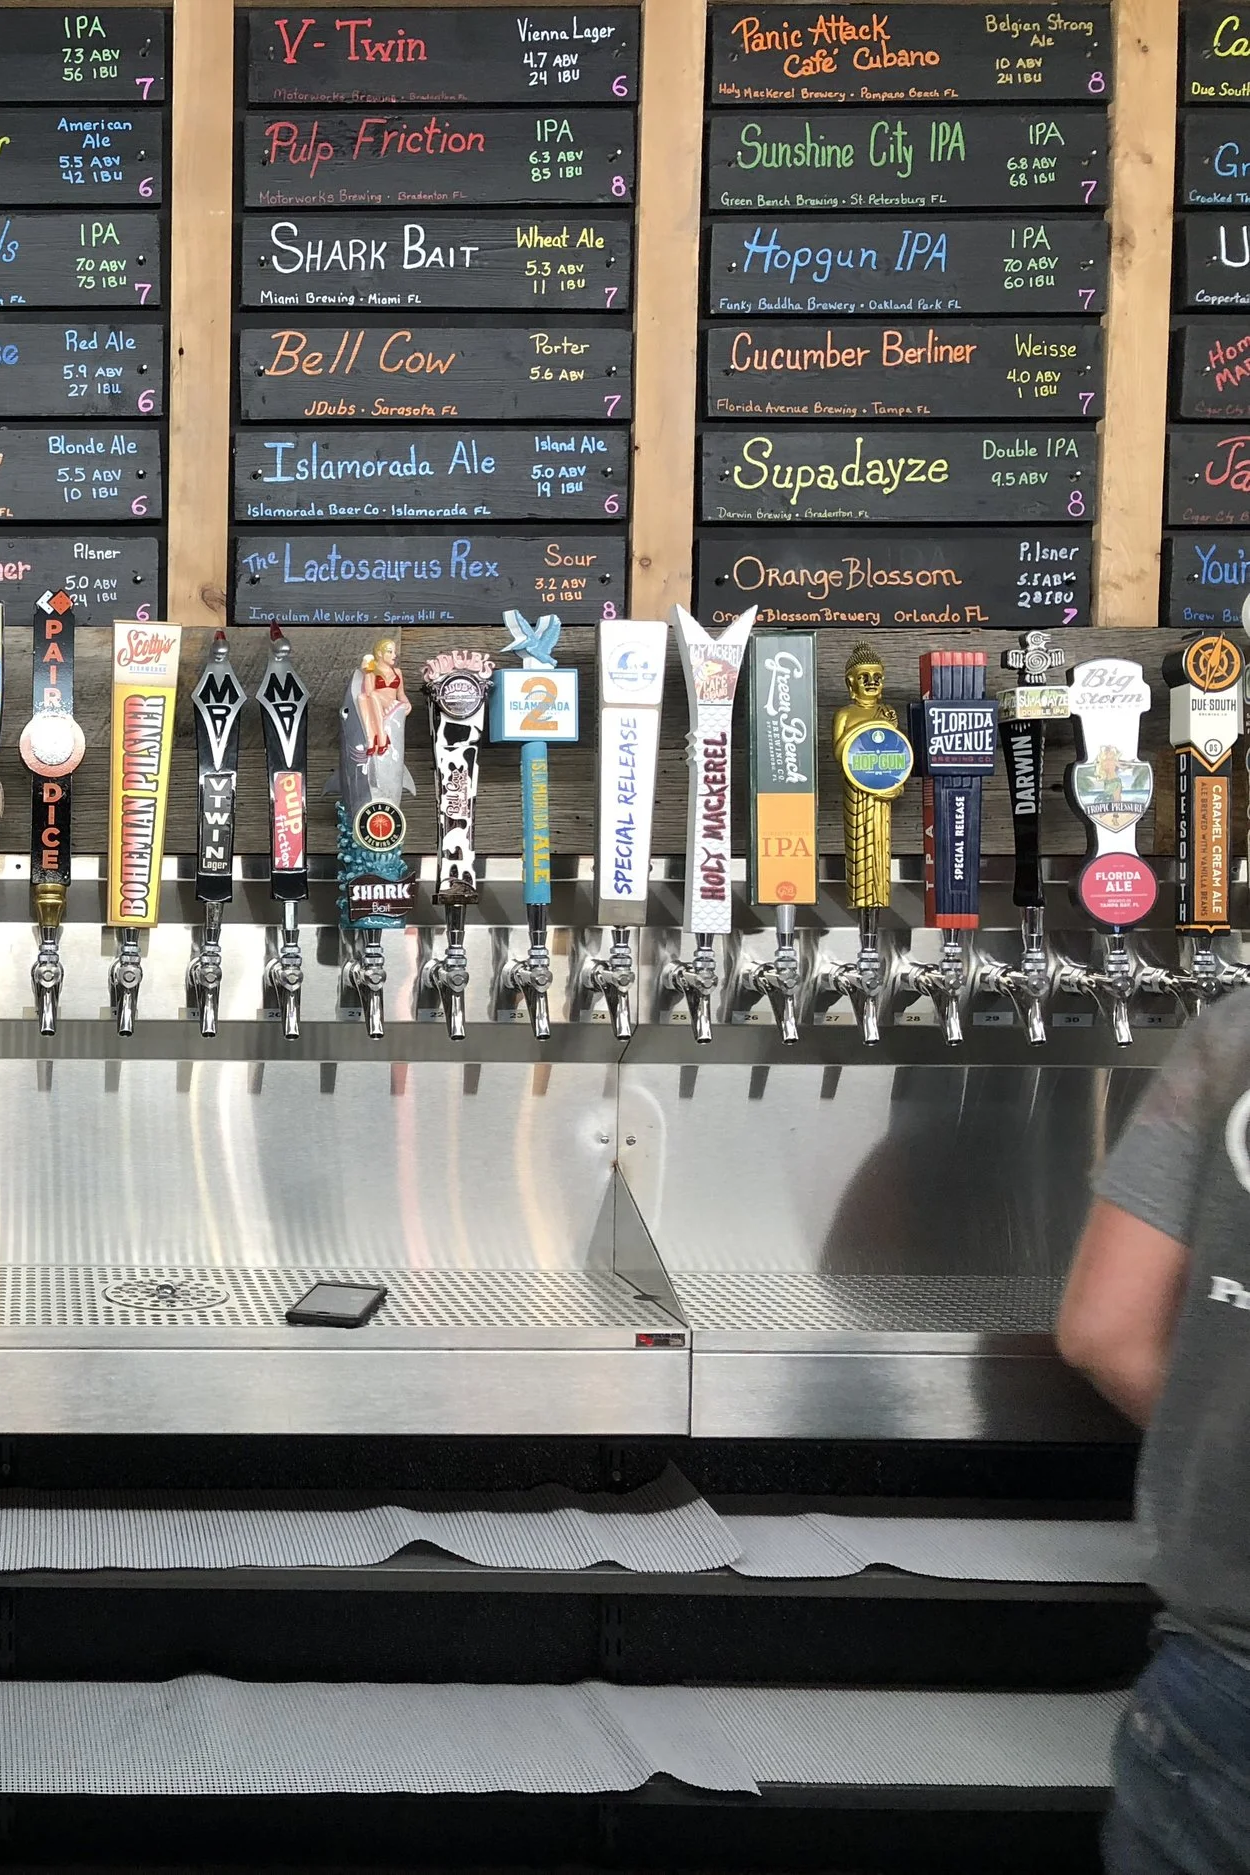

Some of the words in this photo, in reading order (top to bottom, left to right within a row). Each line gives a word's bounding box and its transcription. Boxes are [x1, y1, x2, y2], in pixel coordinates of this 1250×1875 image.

[516, 17, 570, 42] Vienna
[572, 15, 616, 44] Lager
[731, 16, 803, 54] Panic
[807, 12, 891, 46] Attack
[783, 47, 839, 79] Café
[852, 46, 940, 71] Cubano
[57, 117, 132, 132] American
[82, 132, 111, 149] Ale
[264, 120, 334, 179] Pulp
[352, 116, 485, 160] Friction
[736, 122, 854, 169] Sunshine
[869, 120, 913, 178] City
[930, 121, 966, 162] IPA
[270, 221, 388, 274] SHARK
[402, 223, 480, 270] BAIT
[516, 224, 570, 249] Wheat
[575, 227, 605, 249] Ale
[743, 226, 877, 284] Hopgun
[894, 230, 947, 273] IPA
[9, 295, 26, 304] FL
[260, 290, 299, 305] Miami
[305, 292, 356, 306] Brewing
[367, 293, 401, 305] Miami
[407, 294, 422, 304] FL
[1078, 289, 1096, 310] 7
[64, 329, 98, 352] Red
[104, 330, 137, 352] Ale
[264, 330, 365, 376] Bell
[379, 330, 456, 375] Cow
[529, 332, 590, 355] Porter
[729, 330, 871, 372] Cucumber
[882, 328, 977, 367] Berliner
[262, 441, 435, 483] Islamorada
[447, 439, 496, 475] Ale
[733, 436, 949, 506] Supadayze
[242, 551, 279, 578] The
[283, 542, 442, 583] Lactosaurus
[450, 539, 500, 581] Rex
[43, 619, 63, 707] PAIR
[117, 629, 176, 666] Scotty's
[764, 651, 803, 716] Green
[1075, 691, 1144, 704] Storm
[1082, 667, 1136, 692] Big
[929, 707, 994, 735] FLORIDA
[930, 729, 994, 755] AVENUE
[122, 694, 166, 793] PILSNER
[617, 718, 638, 806] RELEASE
[780, 717, 807, 784] Bench
[852, 754, 877, 770] HOP
[879, 754, 905, 770] GUN
[702, 732, 728, 841] MACKEREL
[1010, 735, 1037, 815] DARWIN
[41, 782, 62, 870] DICE
[955, 796, 965, 828] RELEASE
[1211, 784, 1223, 840] CARAMEL
[120, 796, 158, 918] BOHEMIAN
[202, 858, 227, 871] Lager
[614, 813, 636, 895] SPECIAL
[762, 836, 812, 858] IPA
[955, 831, 965, 880] SPECIAL
[700, 846, 727, 901] HOLY
[1095, 871, 1141, 881] FLORIDA
[1106, 881, 1132, 893] ALE
[1211, 844, 1223, 894] CREAM
[352, 883, 411, 900] SHARK
[1212, 896, 1222, 914] ALE
